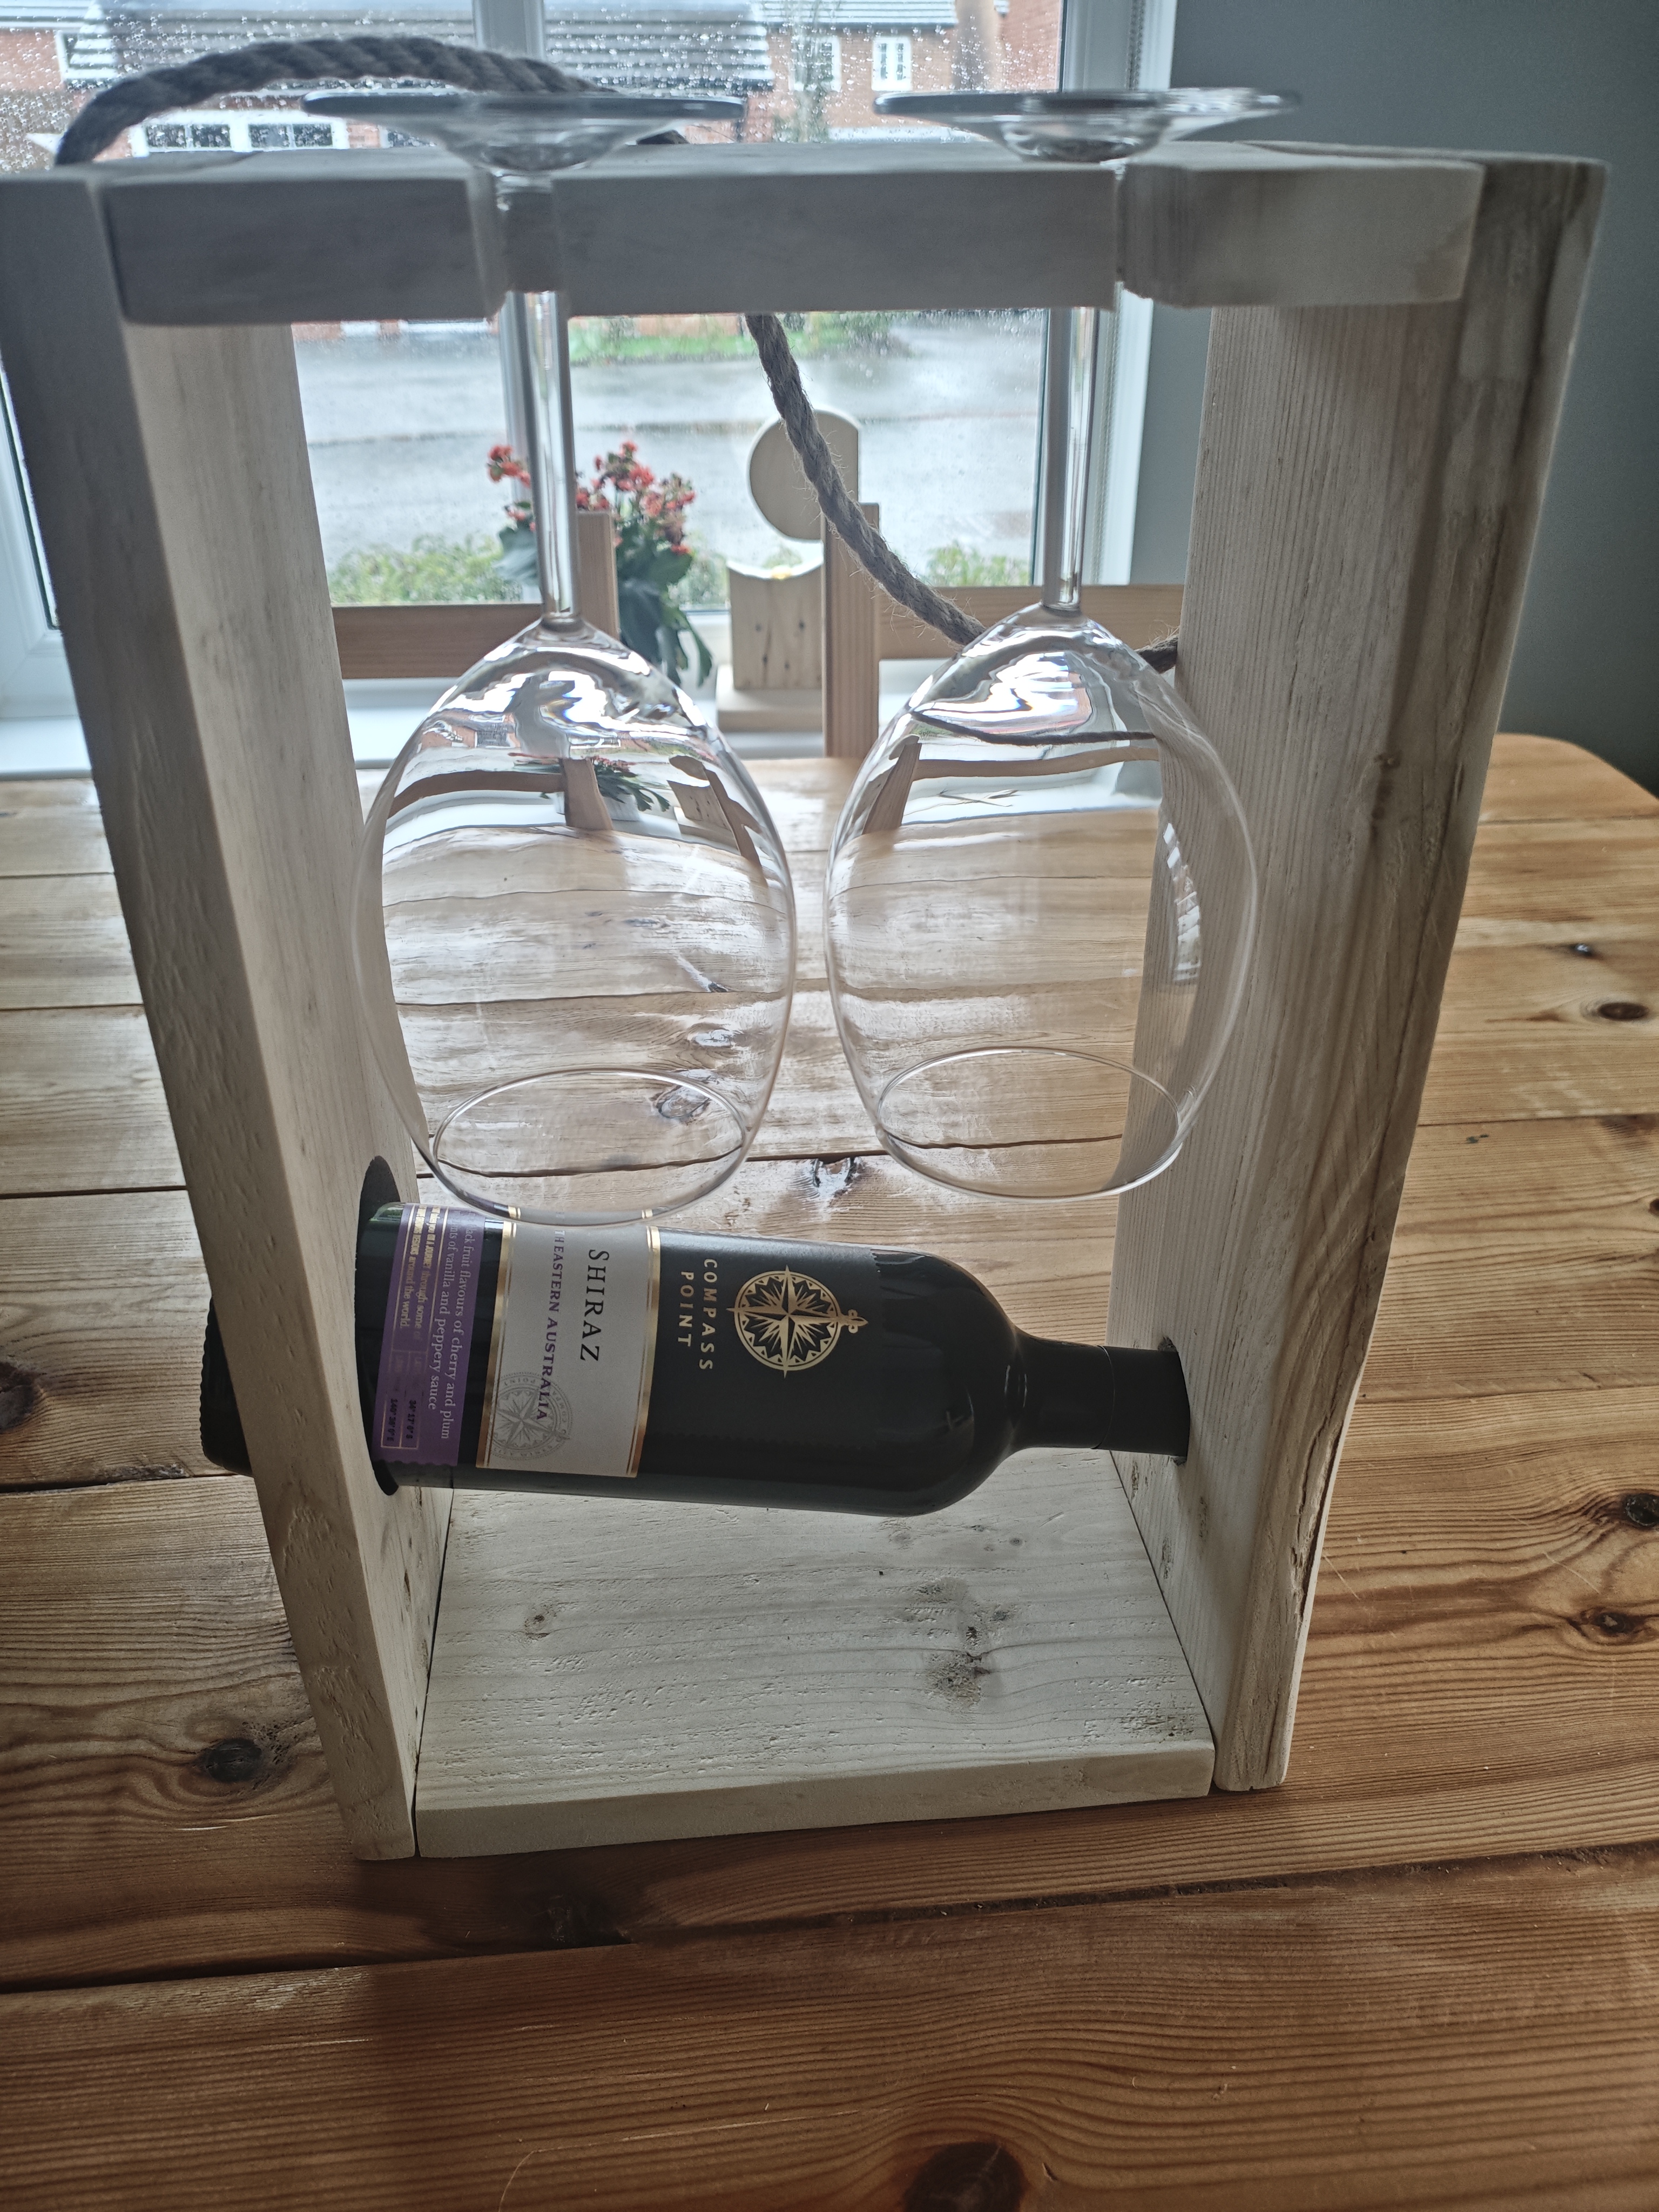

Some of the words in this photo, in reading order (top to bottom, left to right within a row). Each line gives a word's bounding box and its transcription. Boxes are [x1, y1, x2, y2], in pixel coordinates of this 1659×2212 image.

[447, 1242, 458, 1252] of
[464, 1224, 477, 1243] lack
[442, 1252, 455, 1288] vanilla
[461, 1246, 475, 1270] fruit
[403, 1284, 414, 1299] the
[415, 1271, 430, 1303] through
[455, 1270, 471, 1317] flavours
[549, 1245, 564, 1312] EASTERN
[415, 1304, 426, 1329] some
[440, 1291, 451, 1315] and
[579, 1249, 610, 1361] SHIRAZ
[678, 1271, 694, 1347] POINT
[699, 1258, 718, 1370] COMPASS
[453, 1319, 464, 1336] of
[429, 1318, 446, 1373] peppery
[444, 1337, 463, 1380] cherry
[537, 1317, 558, 1420] AUSTRALIA
[428, 1375, 440, 1410] sauce
[444, 1383, 456, 1407] and
[440, 1410, 454, 1439] plum
